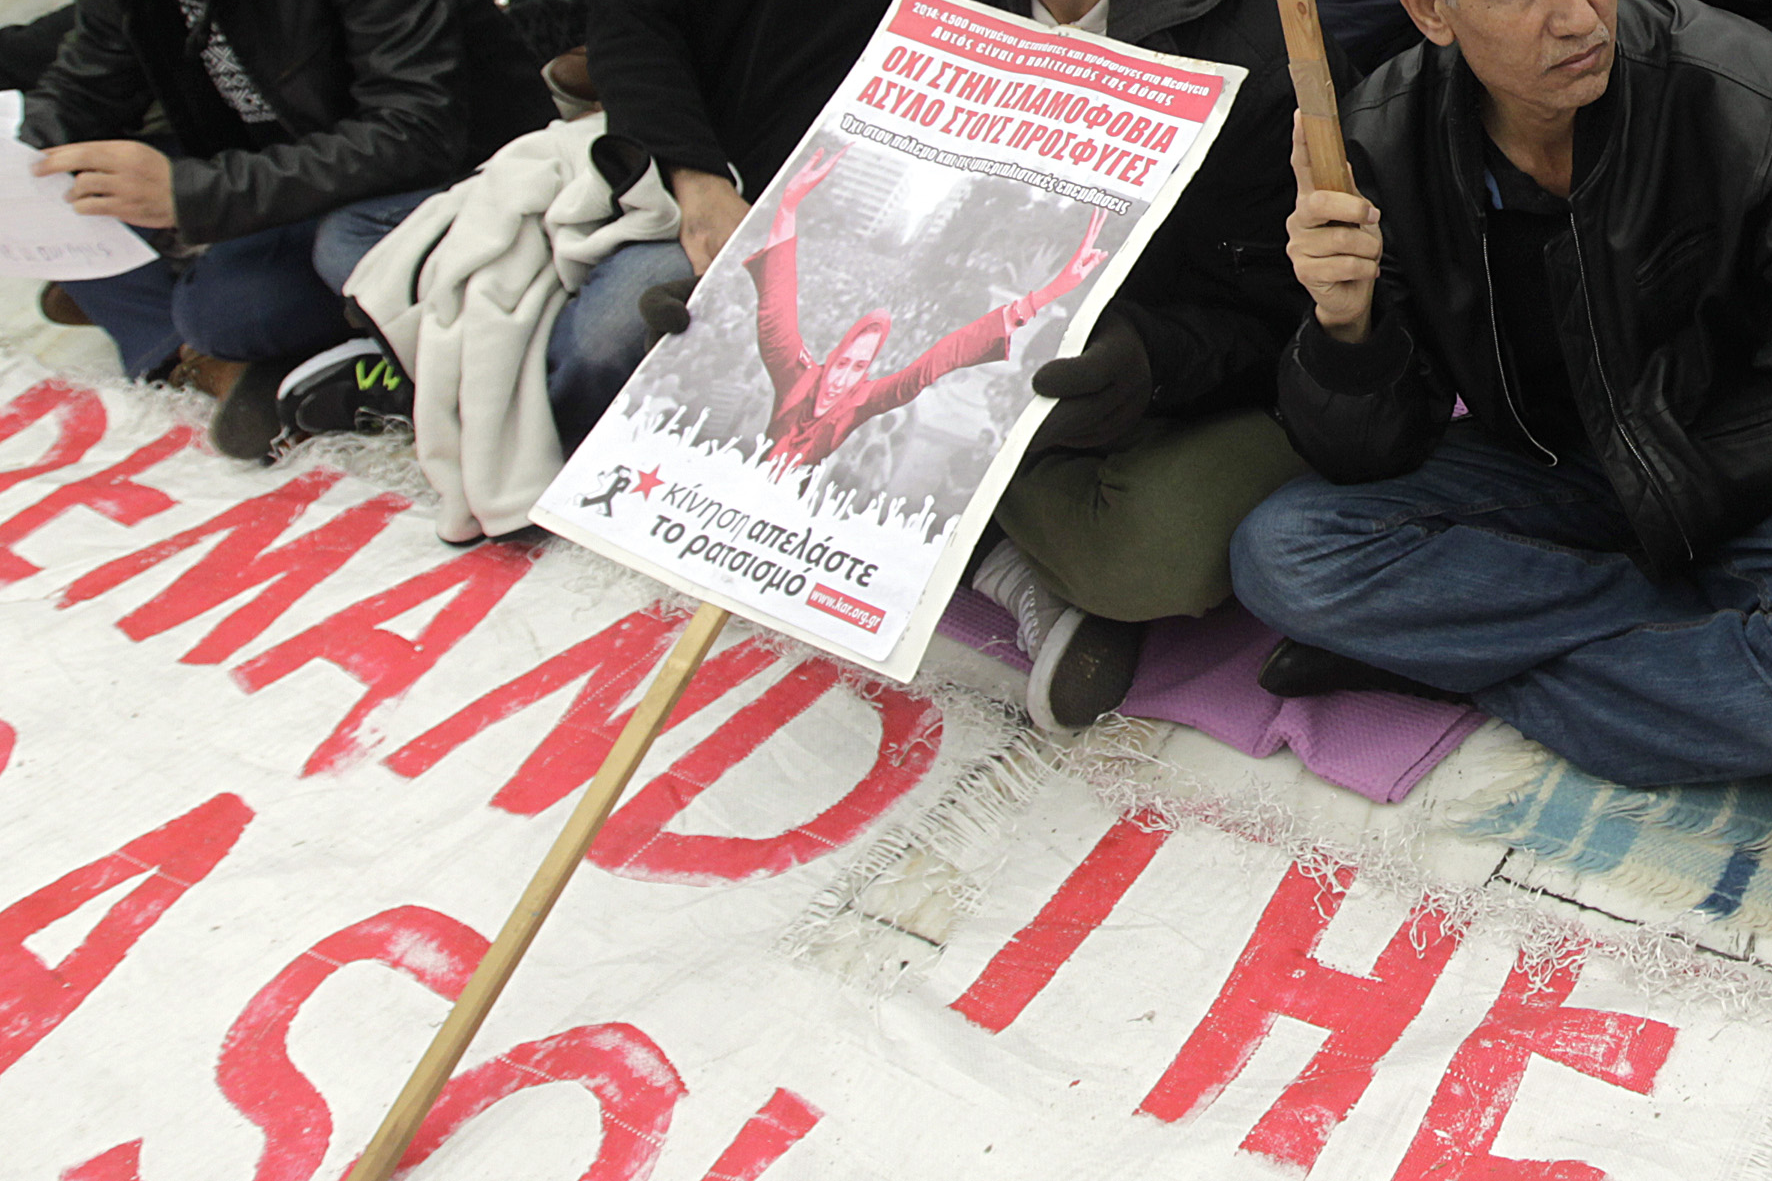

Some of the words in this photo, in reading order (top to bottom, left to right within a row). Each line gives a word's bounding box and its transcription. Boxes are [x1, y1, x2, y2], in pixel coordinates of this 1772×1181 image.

[912, 2, 940, 19] 2014:
[940, 12, 970, 29] 4.500
[968, 23, 1018, 47] πνιγμένοι
[1067, 48, 1084, 59] και
[1084, 53, 1143, 79] πρόσφυγες
[1142, 73, 1160, 86] στη
[1160, 76, 1210, 96] Μεσόγειο
[931, 26, 974, 50] Αυτός
[976, 43, 1014, 62] είναι
[1015, 54, 1026, 65] ο
[1026, 56, 1099, 81] πολιτισμός
[1101, 75, 1127, 91] της
[1128, 83, 1175, 106] Δύσης
[856, 76, 945, 127] ΑΣΥΛΟ
[939, 106, 1014, 144] ΣΤΟΥΣ
[1005, 120, 1159, 187] ΠΡΟΣΦΥΓΕΣ
[882, 46, 934, 81] ΟΧΙ
[927, 61, 1001, 105] ΣΤΗΝ
[994, 81, 1178, 153] ΙΣΛΑΜΟΦΟΒΙΑ
[862, 124, 893, 145] στον
[889, 135, 939, 162] πόλεμο
[935, 150, 959, 167] και
[1054, 180, 1132, 216] επεμβάσεις
[650, 515, 685, 543] το
[678, 535, 812, 596] ρατσισμό
[661, 483, 750, 543] κίνηση
[746, 520, 879, 587] απελάστε
[810, 588, 881, 628] www.kar.org.gr
